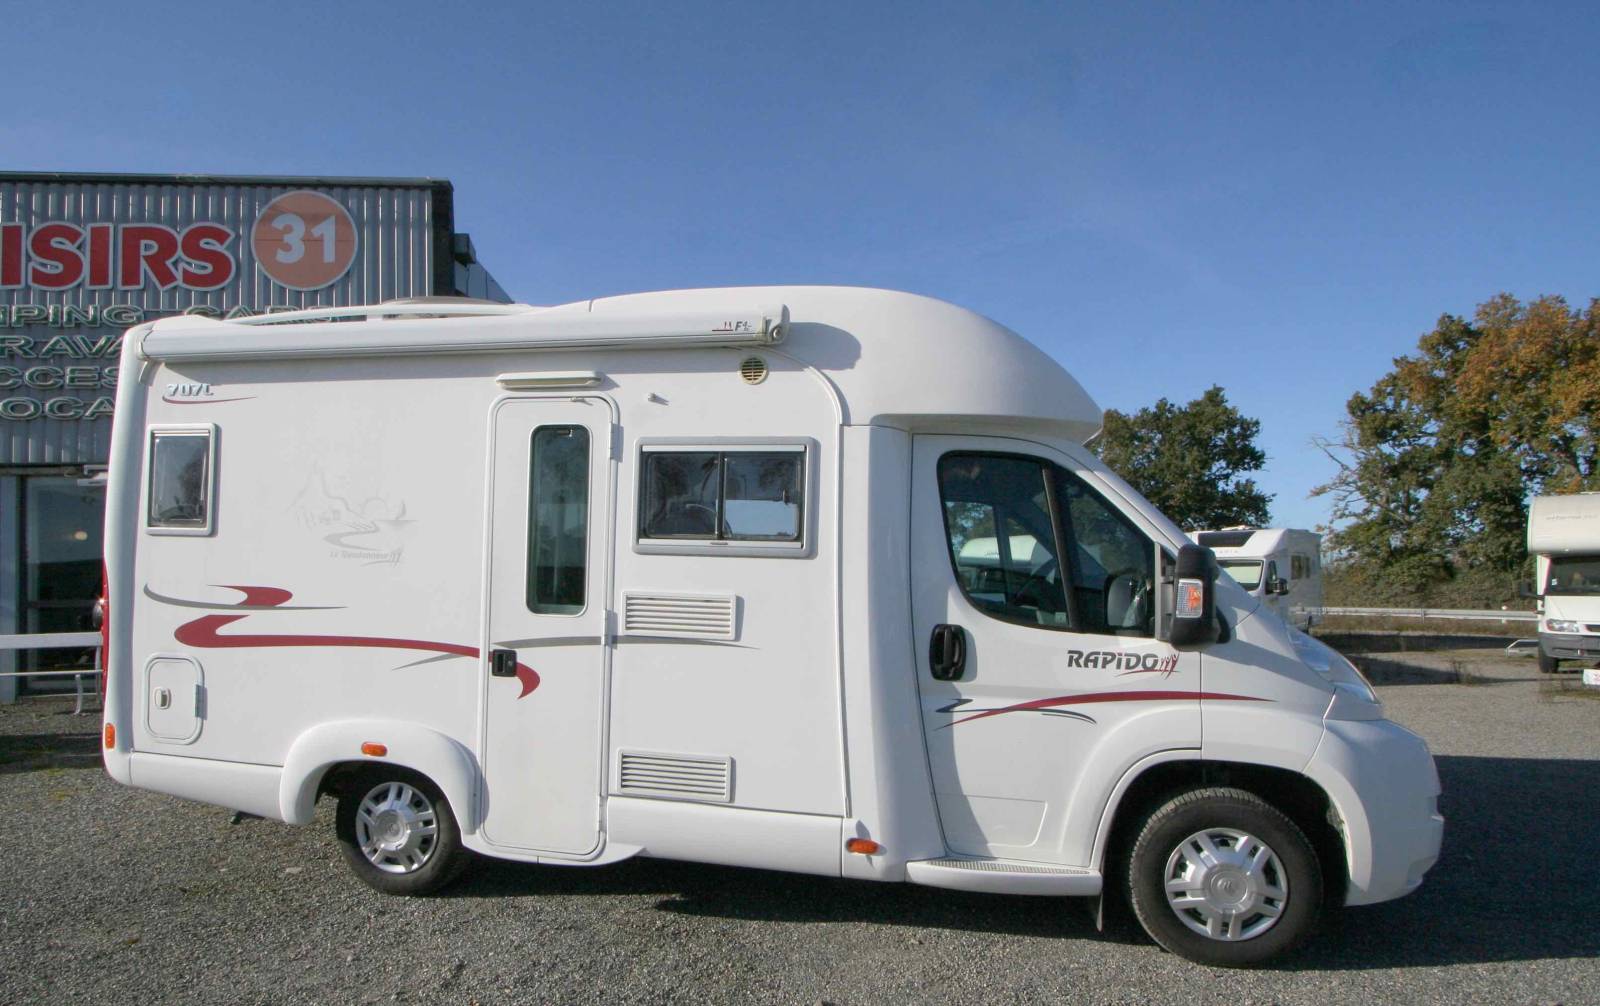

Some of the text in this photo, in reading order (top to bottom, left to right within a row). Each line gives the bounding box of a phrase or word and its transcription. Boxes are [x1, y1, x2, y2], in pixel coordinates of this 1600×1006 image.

[0, 213, 336, 291] ISIRS 31
[0, 304, 144, 327] PING
